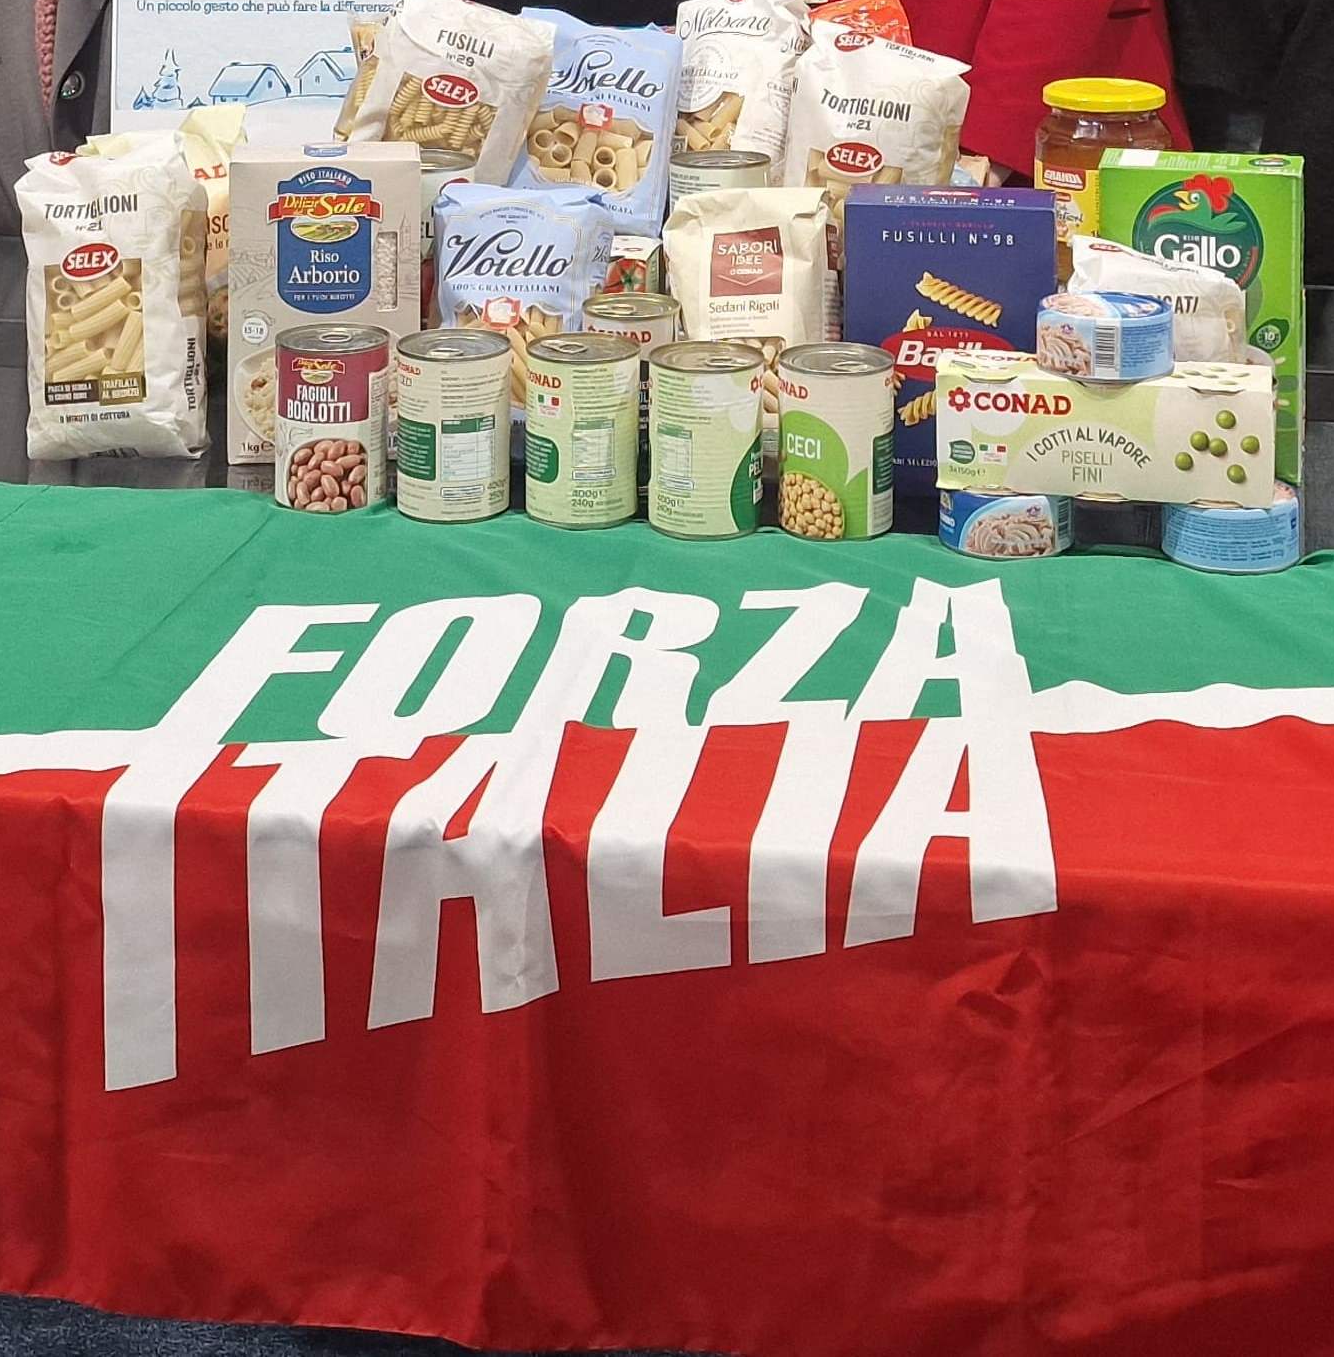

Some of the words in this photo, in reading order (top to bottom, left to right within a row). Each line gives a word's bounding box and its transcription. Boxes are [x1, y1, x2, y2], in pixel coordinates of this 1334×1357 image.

[136, 0, 154, 11] Un
[158, 0, 201, 13] piccolo
[203, 1, 239, 14] gesto
[242, 0, 264, 12] che
[267, 0, 291, 14] può
[293, 1, 317, 12] fare
[319, 1, 330, 12] la
[437, 29, 494, 58] FUSILLI
[837, 33, 872, 48] SELEX
[428, 77, 476, 104] SELEX
[606, 94, 652, 112] ITALIANI
[820, 89, 911, 122] TORTIGLIONI
[831, 148, 880, 170] SELEX
[319, 169, 352, 185] ITALIANO
[44, 193, 138, 220] TORTIGLIONI
[309, 197, 366, 219] Sole
[882, 230, 956, 244] FUSILLI
[66, 250, 115, 270] SELEX
[310, 249, 339, 263] Riso
[444, 229, 573, 281] Voiello
[1154, 234, 1241, 268] Gallo
[287, 265, 360, 284] Arborio
[478, 284, 511, 292] GRANI
[514, 285, 560, 293] ITALIANI
[709, 299, 745, 313] Sedani
[749, 299, 779, 313] Rigati
[185, 337, 196, 411] TORTIGLIONI
[297, 385, 337, 402] FAGIOLI
[974, 392, 1072, 415] CONAD
[288, 399, 350, 422] BORLOTTI
[786, 433, 821, 460] CECI
[1033, 430, 1072, 457] COTTI
[1075, 428, 1095, 442] AL
[1098, 430, 1152, 470] VAPORE
[1061, 449, 1114, 467] PISELLI
[1071, 467, 1103, 483] FINI
[157, 577, 1029, 742] FORZA
[101, 710, 1059, 1092] ITALIA
